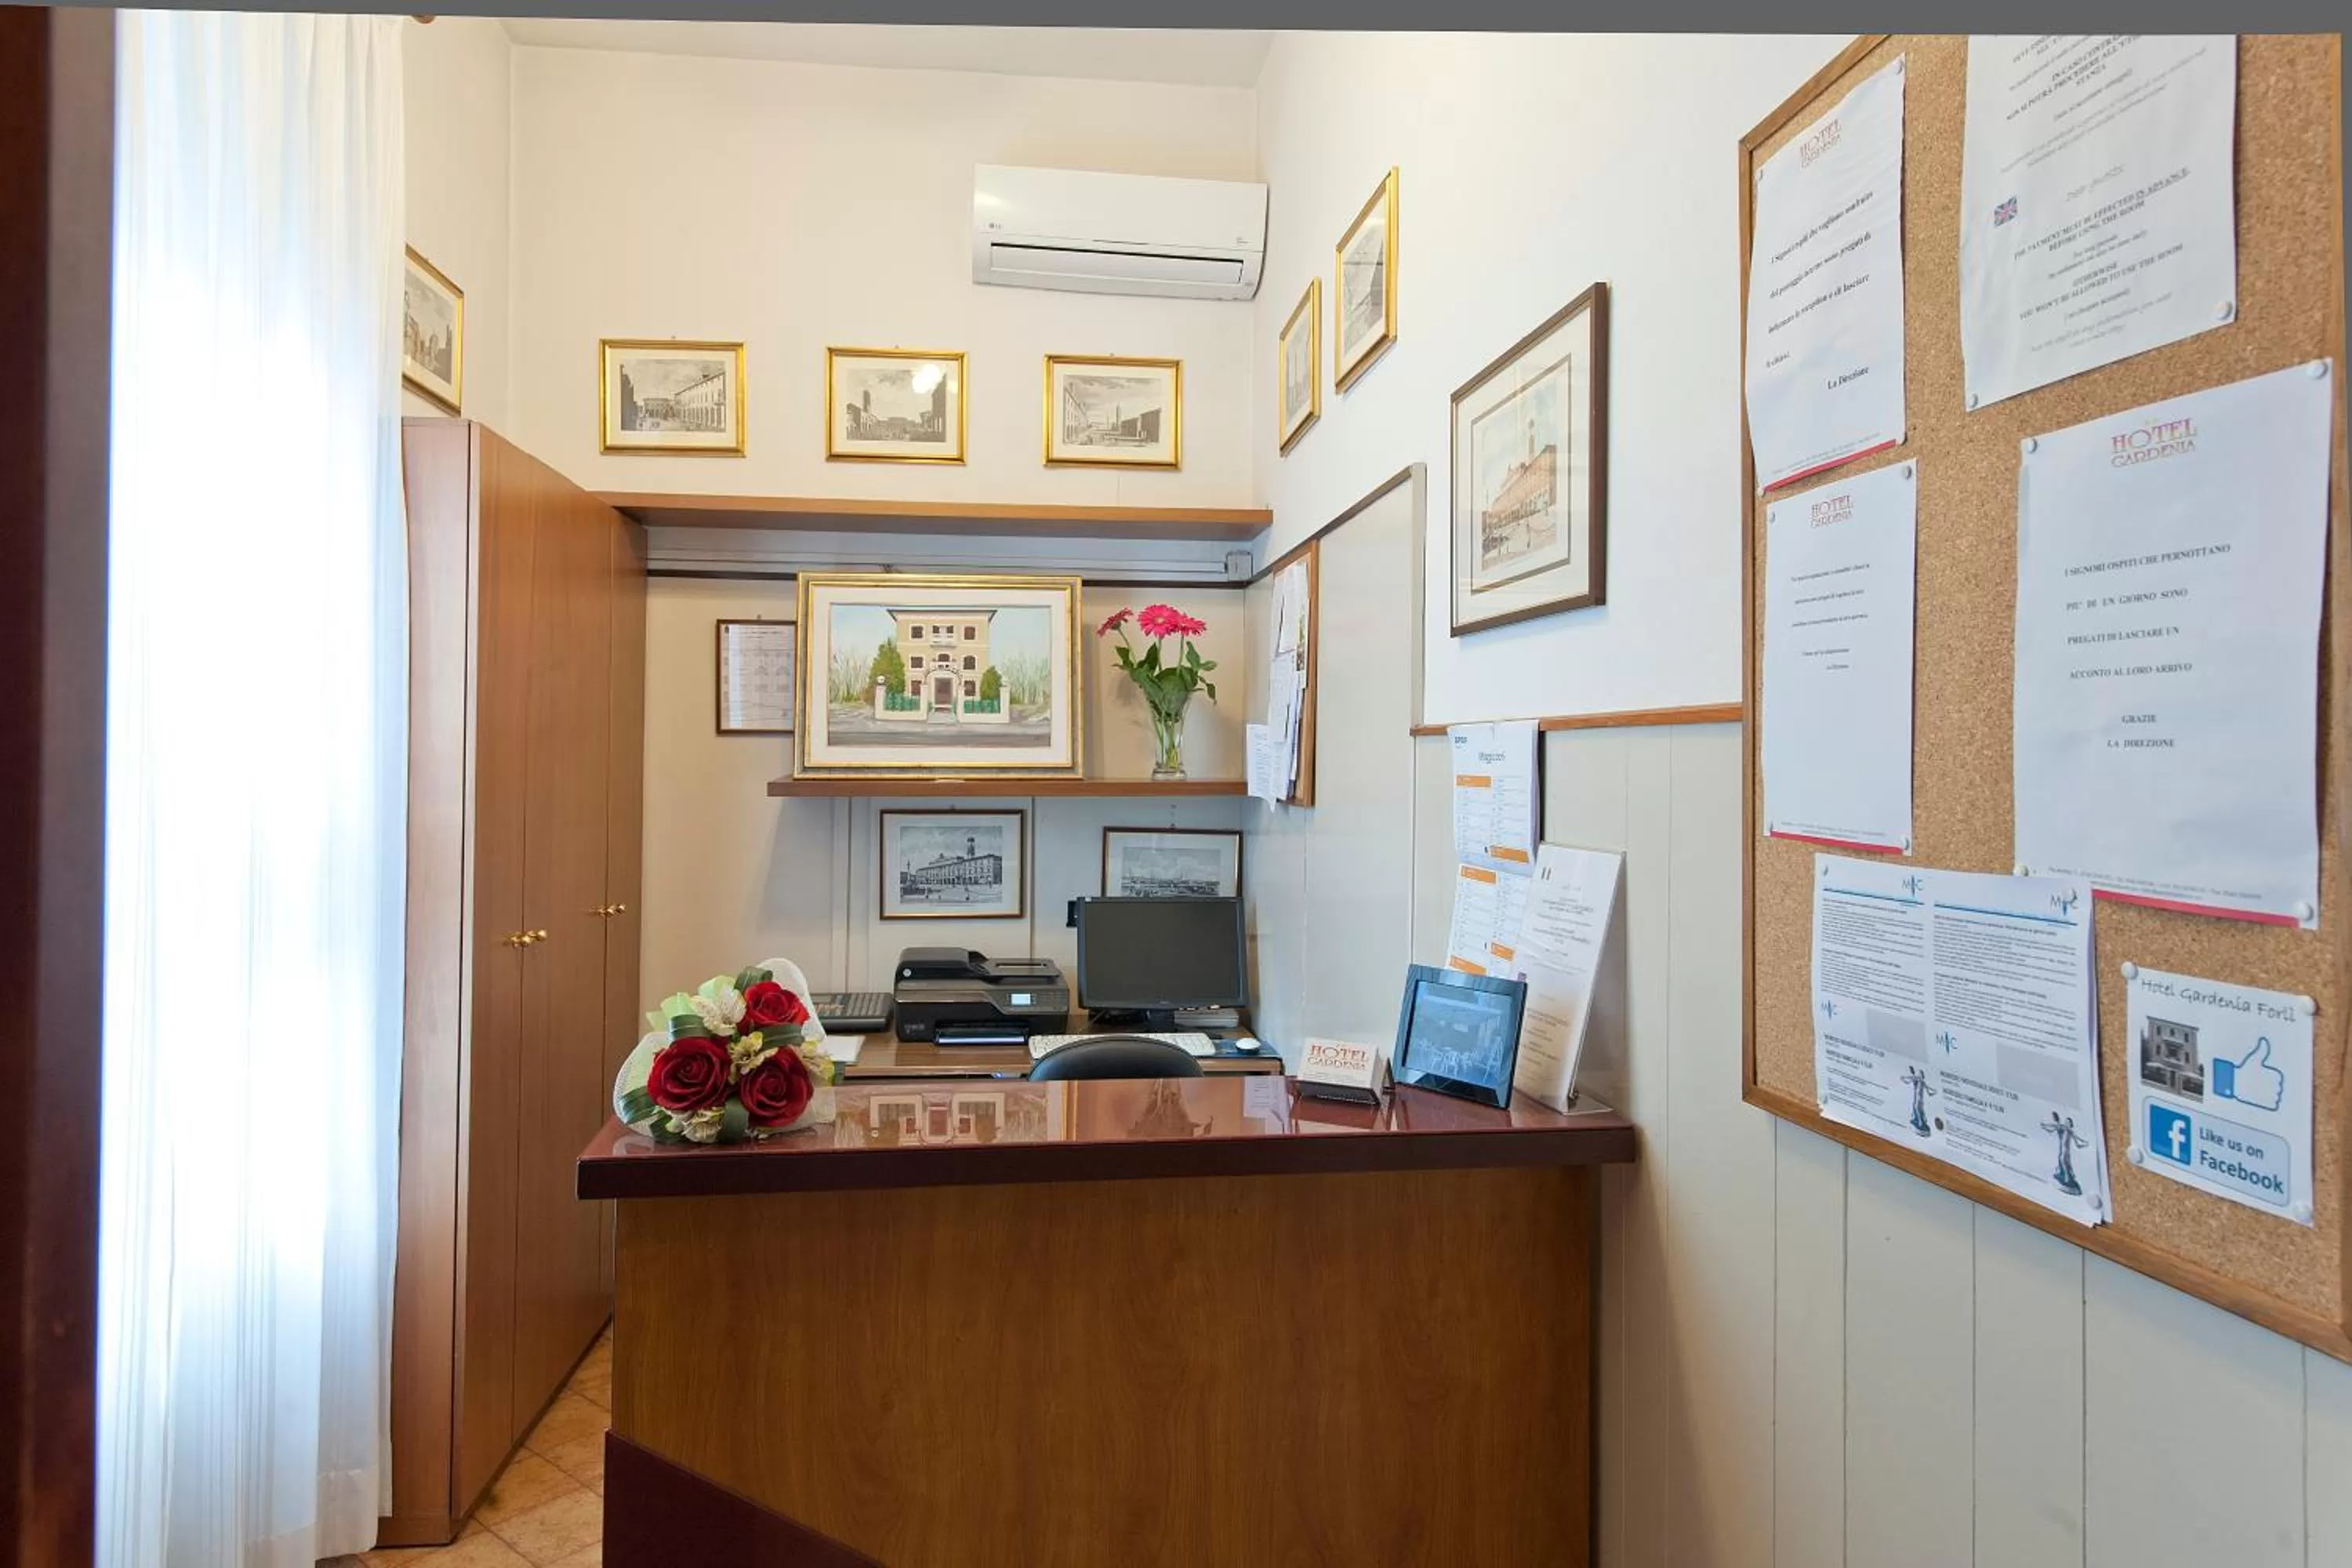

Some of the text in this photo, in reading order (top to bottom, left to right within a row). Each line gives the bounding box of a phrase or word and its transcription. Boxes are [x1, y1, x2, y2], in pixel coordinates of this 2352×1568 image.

[2111, 417, 2198, 455] HOTEL
[2111, 439, 2196, 468] GARDENIA
[2161, 543, 2231, 564] PERNOTTANO
[2160, 587, 2189, 601] SONO
[2118, 628, 2165, 641] LASCIARE
[2154, 662, 2193, 674] ARRIVO
[2122, 714, 2157, 724] GRAZIE
[2123, 739, 2175, 748] DIREZIONE
[2141, 979, 2176, 997] Hotel
[2180, 988, 2252, 1012] Gardenia
[1309, 1044, 1367, 1062] HOTEL
[2198, 1126, 2264, 1160] Like us on
[2199, 1149, 2285, 1195] Facebook
